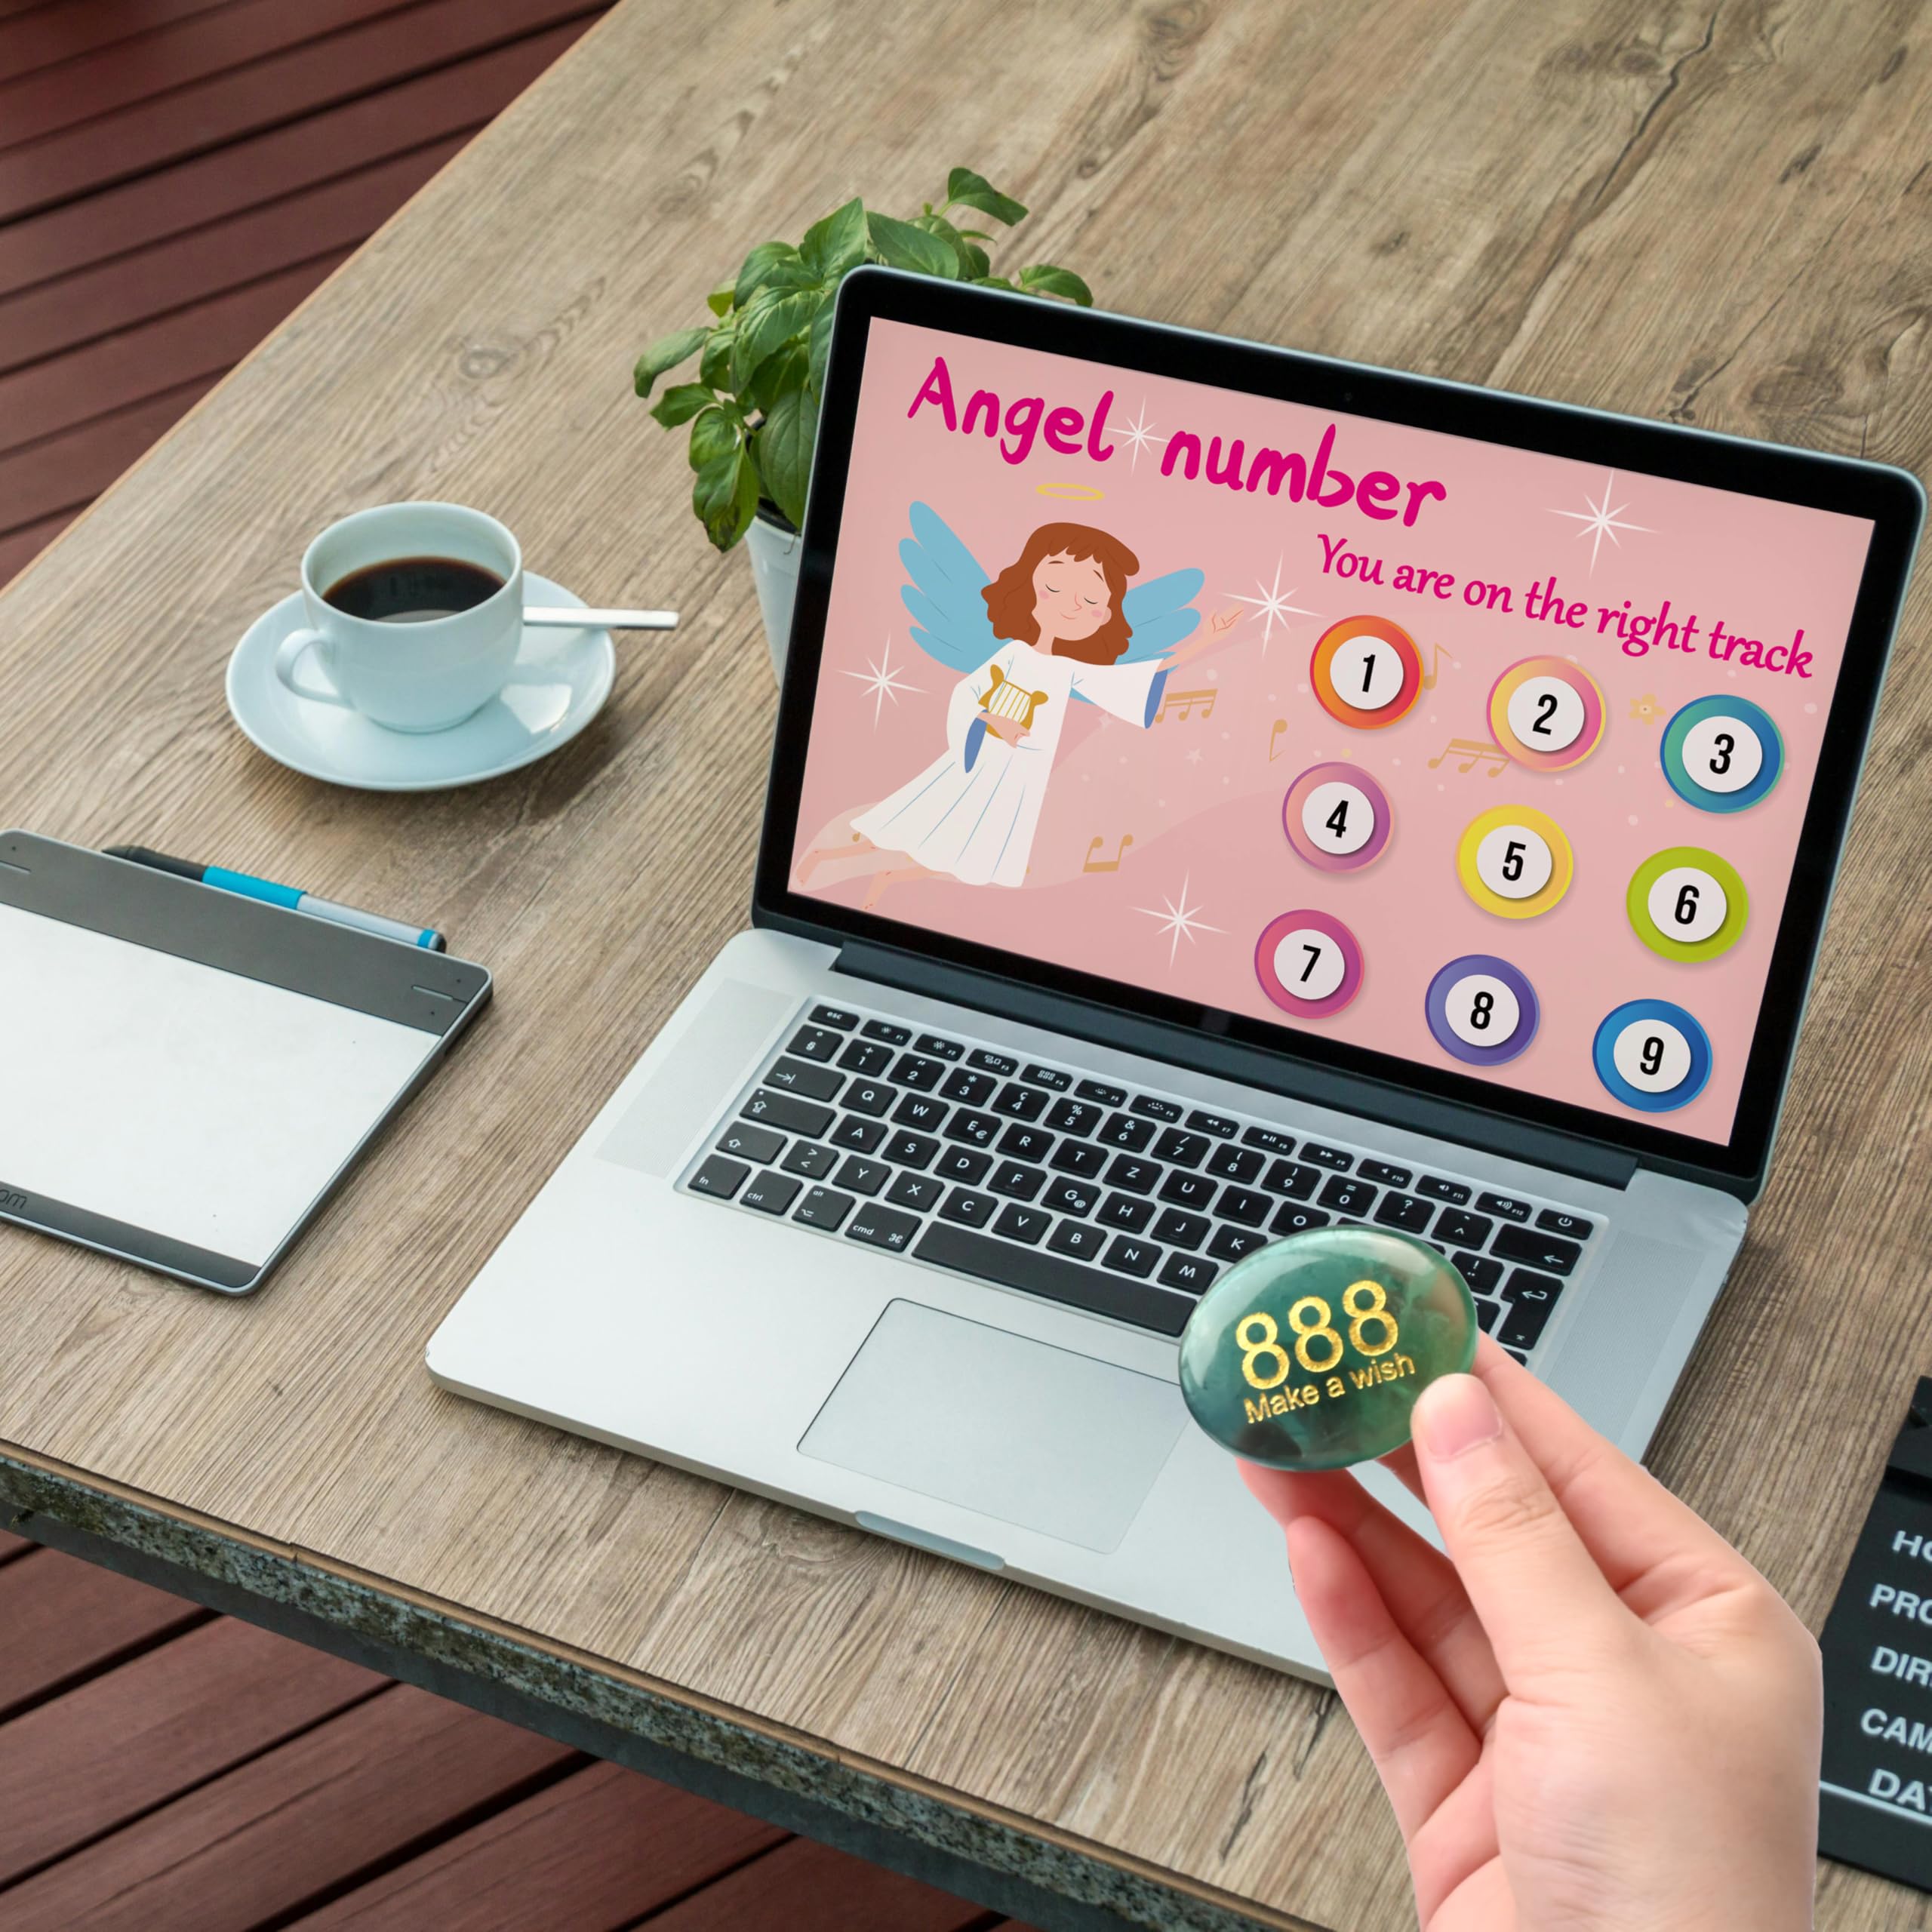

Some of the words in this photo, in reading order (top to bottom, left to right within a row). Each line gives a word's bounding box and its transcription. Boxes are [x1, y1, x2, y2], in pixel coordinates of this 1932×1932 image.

[907, 356, 1115, 465] Angel
[1160, 423, 1447, 528] number
[1318, 534, 1385, 586] You
[1392, 565, 1456, 600] are
[1463, 580, 1514, 614] on
[1524, 576, 1589, 629] the
[1597, 600, 1700, 657] right
[1708, 620, 1814, 678] track
[1362, 654, 1376, 693] 1
[1532, 694, 1558, 735] 2
[1709, 734, 1735, 774] 3
[1325, 800, 1349, 838] 4
[1502, 841, 1526, 881] 5
[1675, 884, 1700, 924] 6
[1300, 944, 1321, 982] 7
[826, 1010, 844, 1020] esc
[1470, 991, 1494, 1030] 8
[1640, 1036, 1664, 1075] 9
[907, 1070, 918, 1081] 2
[861, 1090, 875, 1102] Q
[958, 1085, 970, 1096] 3
[912, 1104, 930, 1117] W
[1012, 1100, 1023, 1111] 4
[1072, 1104, 1082, 1115] %
[967, 1120, 979, 1131] E
[1064, 1115, 1076, 1126] 5
[1124, 1120, 1135, 1130] &
[851, 1128, 863, 1139] A
[1118, 1131, 1128, 1141] 6
[1019, 1135, 1032, 1147] R
[905, 1143, 917, 1153] S
[1173, 1146, 1184, 1155] 7
[1075, 1151, 1085, 1161] T
[956, 1158, 970, 1168] D
[1227, 1162, 1238, 1172] 8
[858, 1168, 869, 1179] Y
[1126, 1166, 1140, 1178] Z
[699, 1176, 709, 1185] fn
[1011, 1174, 1023, 1183] F
[1284, 1178, 1294, 1188] 9
[906, 1183, 921, 1196] X
[1181, 1182, 1195, 1193] U
[746, 1191, 764, 1201] ctrl
[1064, 1189, 1078, 1201] G
[1339, 1195, 1350, 1204] 0
[961, 1200, 975, 1211] C
[1073, 1198, 1086, 1208] @
[1404, 1199, 1414, 1209] ?
[1118, 1204, 1134, 1217] H
[1017, 1215, 1029, 1227] V
[1293, 1215, 1307, 1226] O
[852, 1223, 875, 1235] cmd
[1175, 1222, 1186, 1232] J
[1070, 1232, 1082, 1244] B
[1230, 1238, 1244, 1251] K
[1124, 1248, 1140, 1261] N
[1178, 1265, 1196, 1278] M
[1236, 1280, 1398, 1389] 888
[1244, 1383, 1320, 1424] Make
[1326, 1376, 1346, 1398] a
[1349, 1353, 1416, 1390] wish
[1871, 1645, 1932, 1687] DIR
[1868, 1767, 1932, 1813] DA
